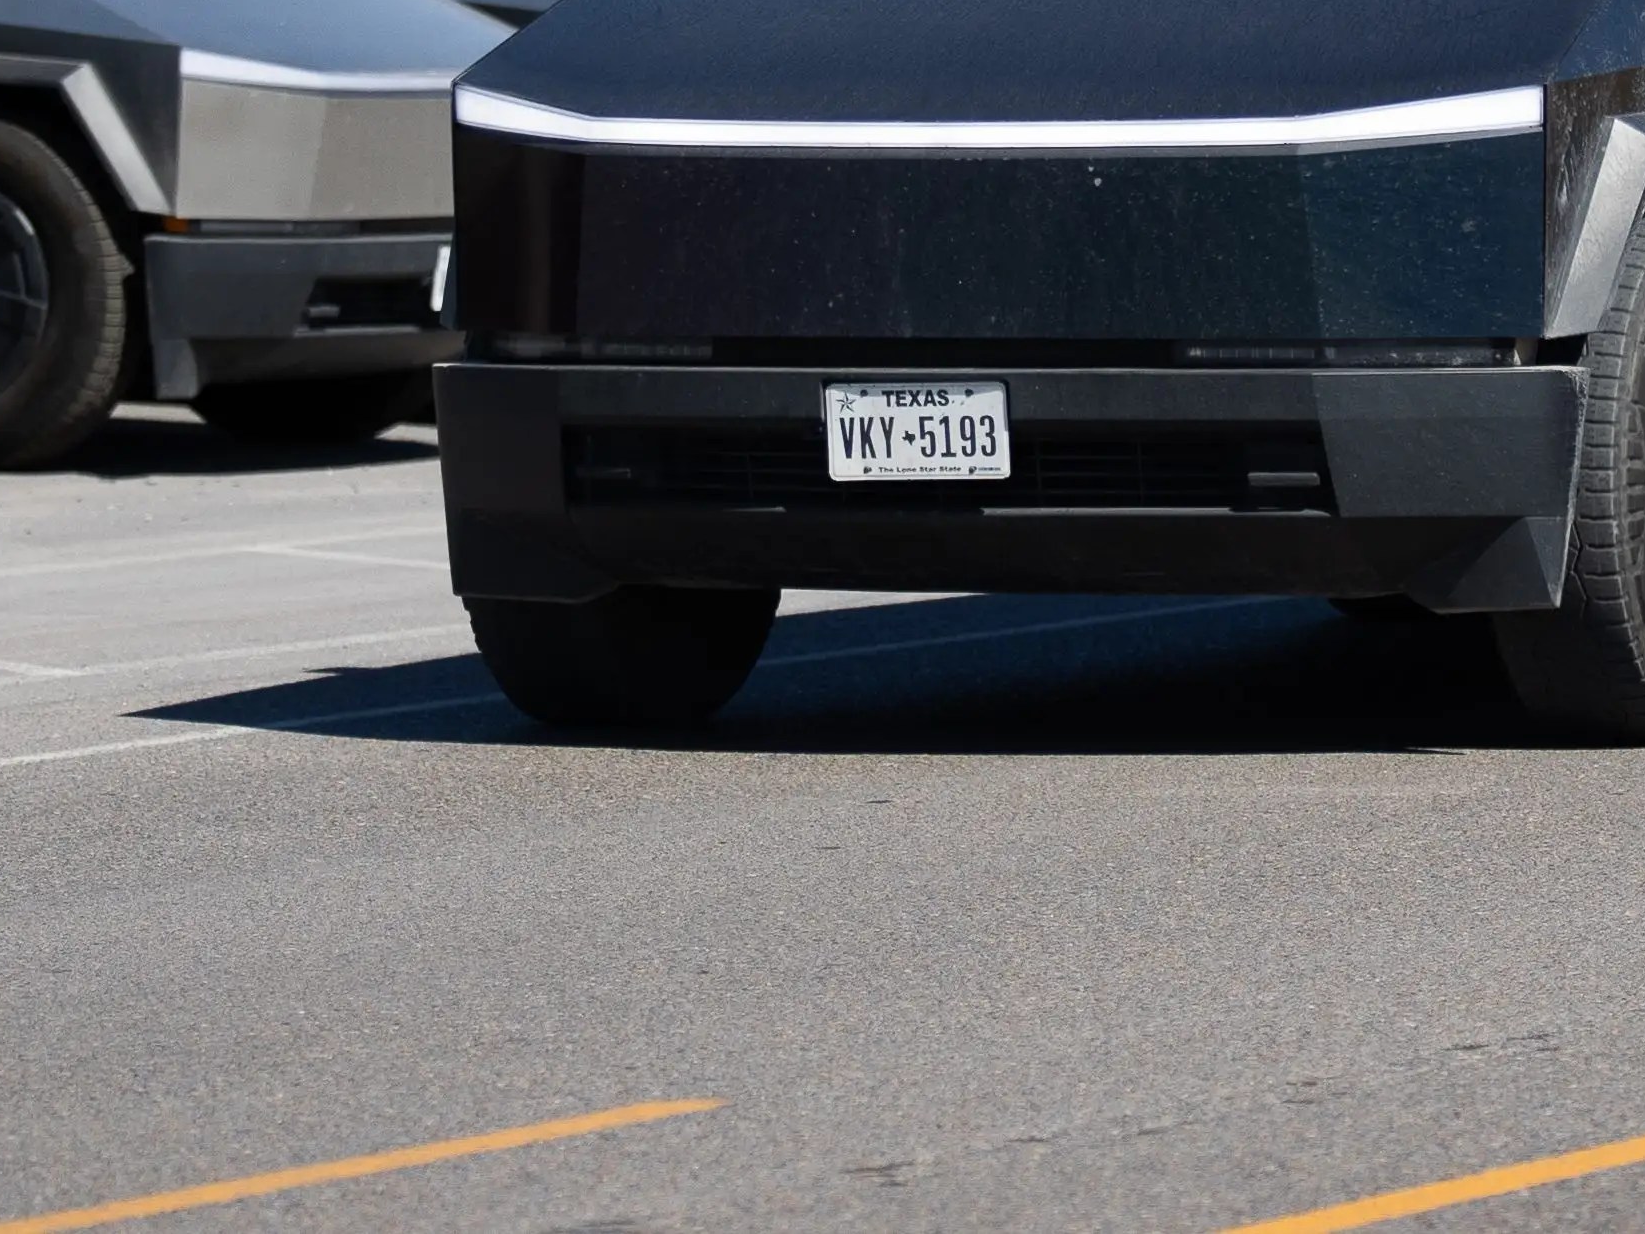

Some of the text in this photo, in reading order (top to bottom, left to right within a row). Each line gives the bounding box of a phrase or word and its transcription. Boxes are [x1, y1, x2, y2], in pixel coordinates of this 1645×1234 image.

[881, 389, 949, 407] TEXAS
[840, 415, 997, 459] VKY 5193
